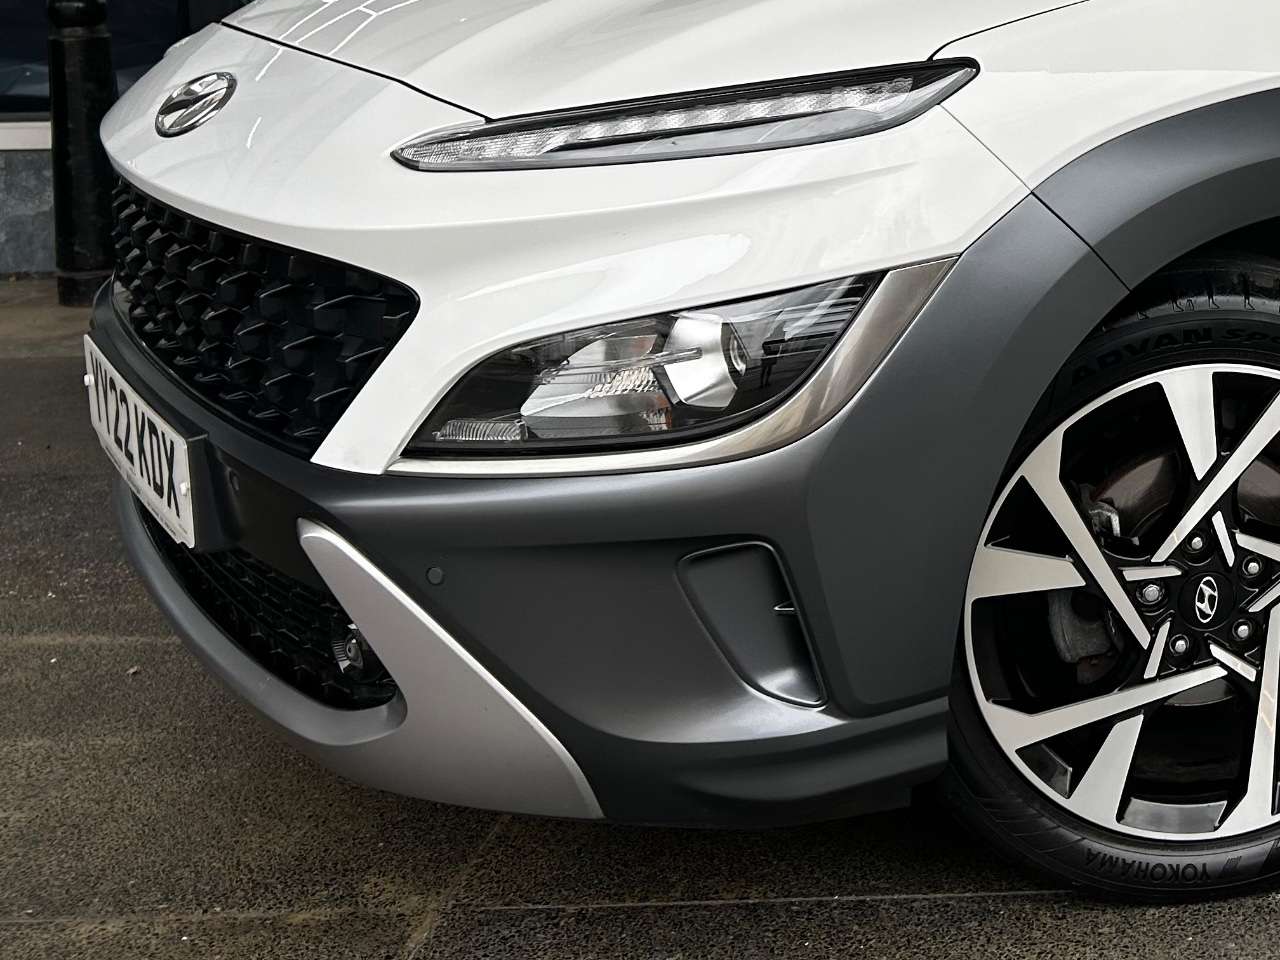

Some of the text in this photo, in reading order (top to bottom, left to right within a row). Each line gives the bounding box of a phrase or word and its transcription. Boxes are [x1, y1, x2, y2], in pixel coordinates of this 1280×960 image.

[1072, 327, 1213, 385] ADVAN
[90, 351, 135, 467] YY22
[134, 403, 181, 519] KDX
[1085, 847, 1211, 884] YOKOHAMA
